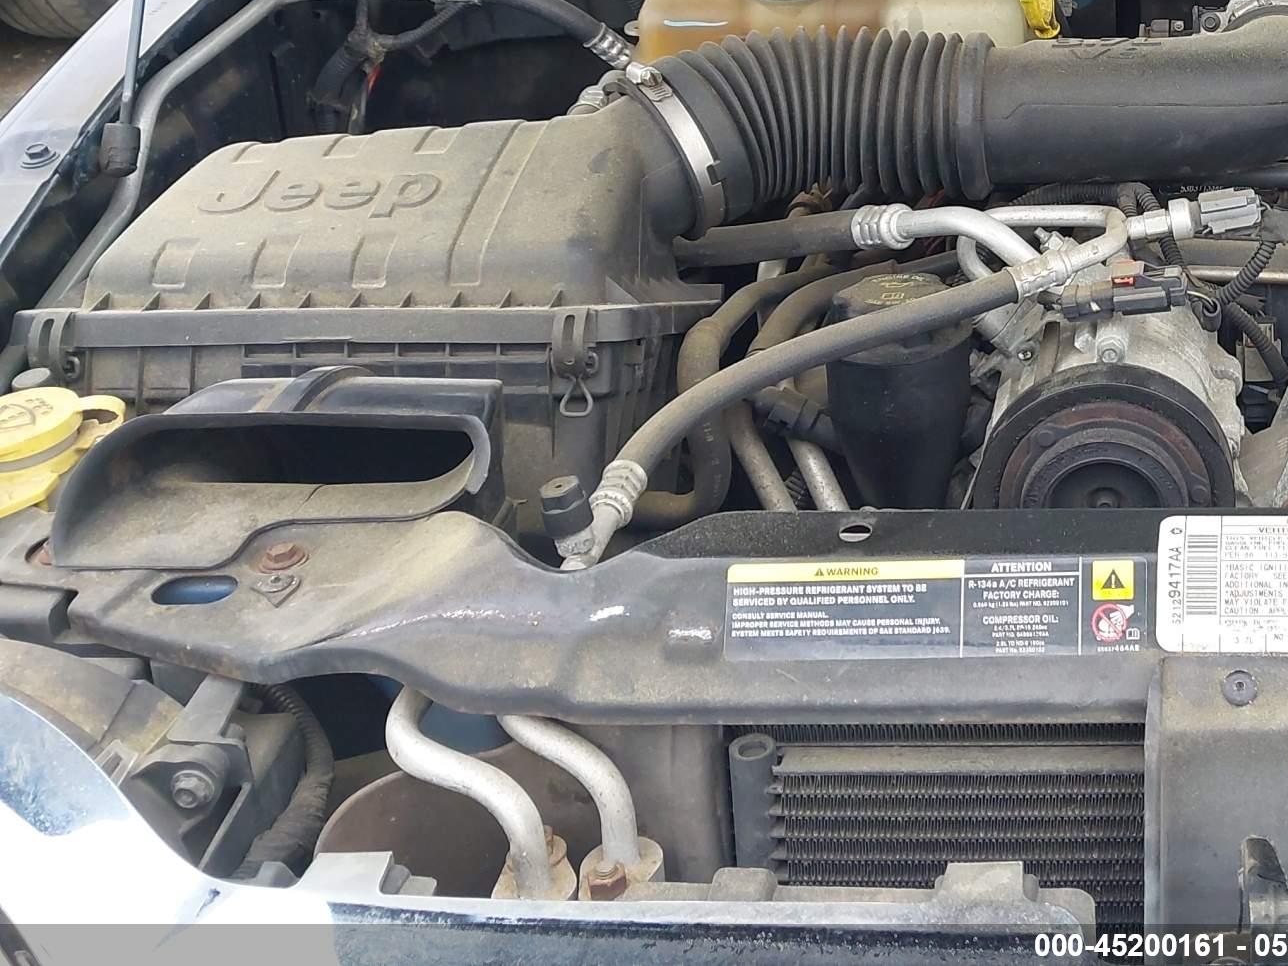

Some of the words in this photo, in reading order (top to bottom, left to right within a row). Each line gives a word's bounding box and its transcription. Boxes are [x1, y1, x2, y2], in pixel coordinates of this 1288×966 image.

[197, 170, 442, 218] Jeep
[827, 567, 878, 576] WARNING
[991, 562, 1052, 573] ATTENTION
[1000, 579, 1016, 589] A/C
[1018, 578, 1075, 586] REFRIGERANT
[733, 586, 804, 595] HIGH-PRESSURE
[806, 585, 865, 594] REFRIGERANT
[866, 585, 900, 593] SYSTEM
[902, 584, 914, 593] TO
[916, 584, 927, 592] BE
[983, 590, 1020, 600] FACTORY
[1023, 590, 1059, 598] CHARGE:
[733, 598, 775, 606] SERVICED
[777, 597, 788, 606] BY
[790, 597, 835, 605] QUALIFIED
[837, 596, 889, 604] PERSONNEL
[891, 595, 915, 603] ONLY.
[732, 612, 764, 620] CONSULT
[983, 616, 1041, 624] COMPRESSOR
[1042, 615, 1059, 623] OIL:
[732, 621, 768, 629] IMPROPER
[800, 620, 834, 628] METHODS
[853, 619, 876, 627] CAUSE
[877, 619, 913, 627] PERSONAL
[732, 630, 759, 638] SYSTEM
[785, 629, 812, 637] SAFETY
